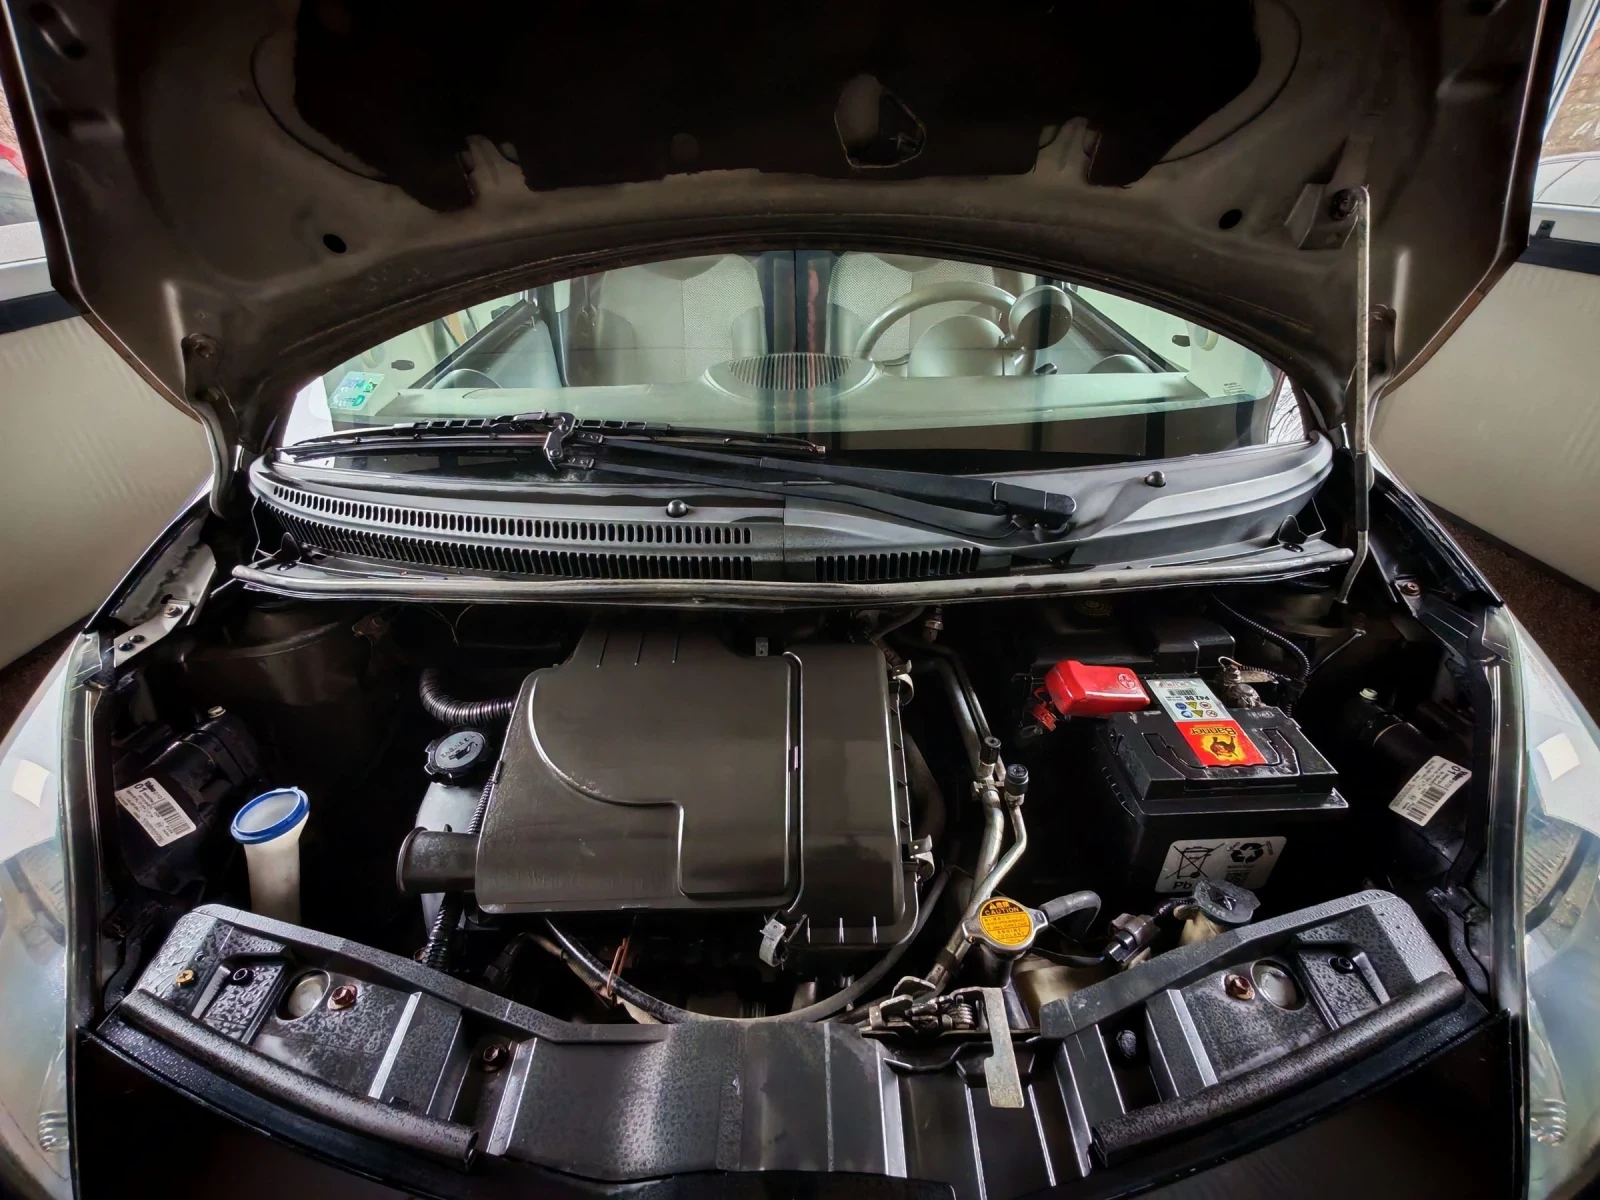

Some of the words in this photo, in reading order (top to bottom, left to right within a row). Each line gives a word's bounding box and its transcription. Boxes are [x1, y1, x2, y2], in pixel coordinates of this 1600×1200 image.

[1190, 727, 1237, 736] Banner
[1172, 881, 1193, 890] Pb
[984, 906, 1020, 916] CAUTION
